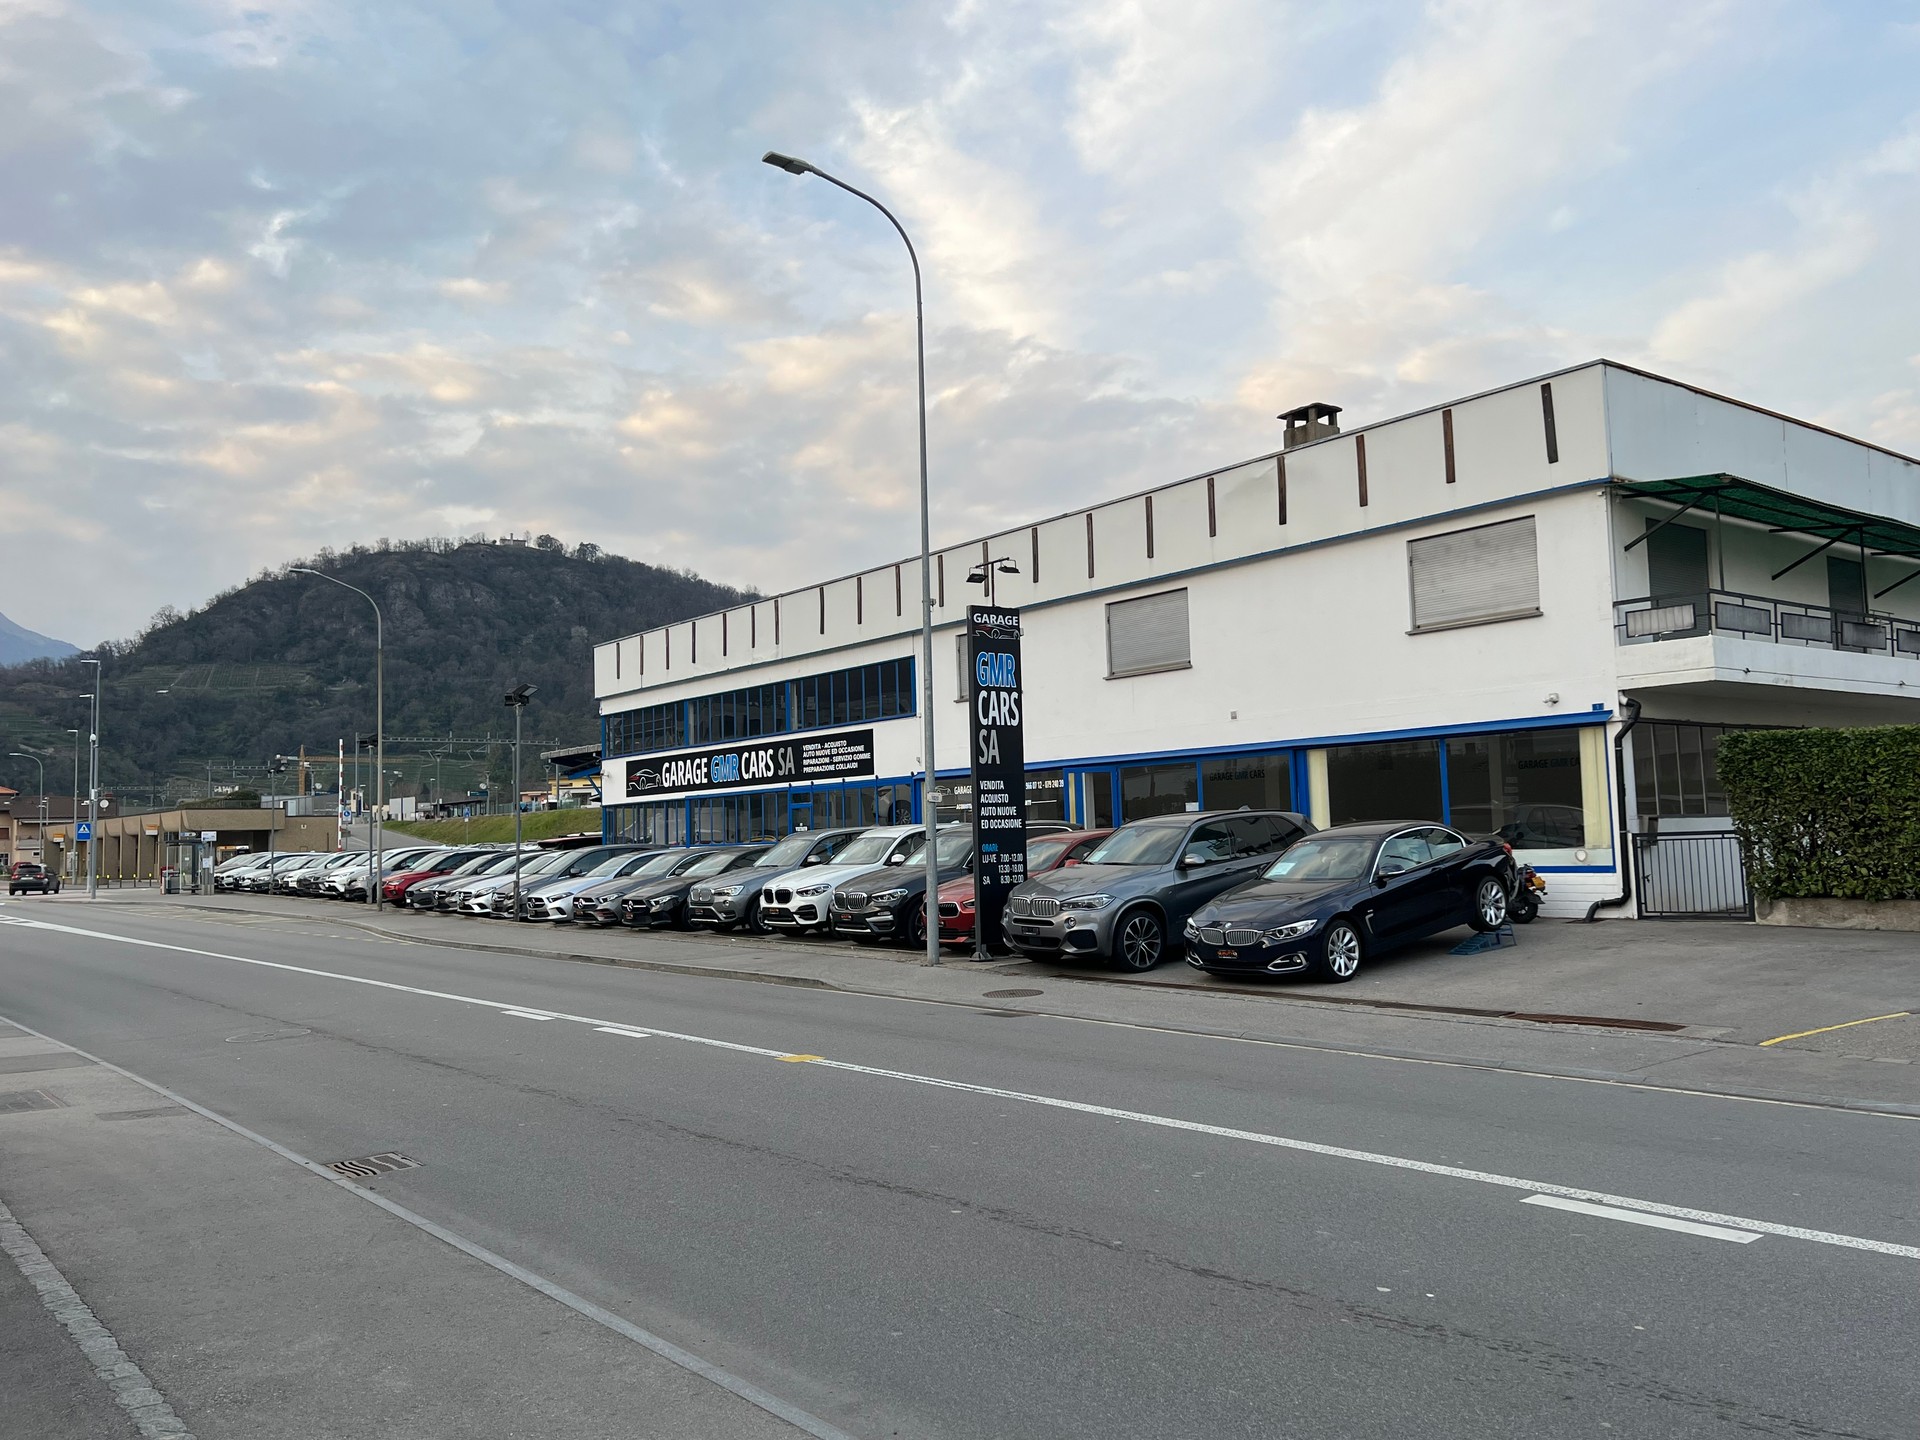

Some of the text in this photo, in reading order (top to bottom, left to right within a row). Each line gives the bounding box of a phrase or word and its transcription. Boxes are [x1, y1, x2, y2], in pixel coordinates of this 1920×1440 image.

[973, 613, 1019, 626] GARAGE
[976, 651, 1017, 688] GMR
[978, 690, 1019, 726] CARS
[803, 743, 821, 751] VENDITA
[824, 740, 847, 748] ACQUISTO
[838, 745, 864, 754] OCCASIONE
[979, 728, 1000, 764] SA
[803, 757, 830, 765] RIPARAZIONI
[662, 747, 795, 787] GARAGE GMR CARS SA
[803, 762, 858, 773] PREPARAZIONE COLLAUDI
[1210, 771, 1233, 781] GARAGE
[1249, 769, 1265, 779] CARS
[953, 785, 972, 794] GARAGE
[980, 780, 1004, 790] VENDITA
[980, 793, 1009, 803] ACQUISTO
[981, 806, 1017, 816] AUTO NUOVE
[981, 819, 1022, 829] ED OCCASIONE
[982, 854, 997, 863] LU-VE
[982, 876, 991, 885] SA
